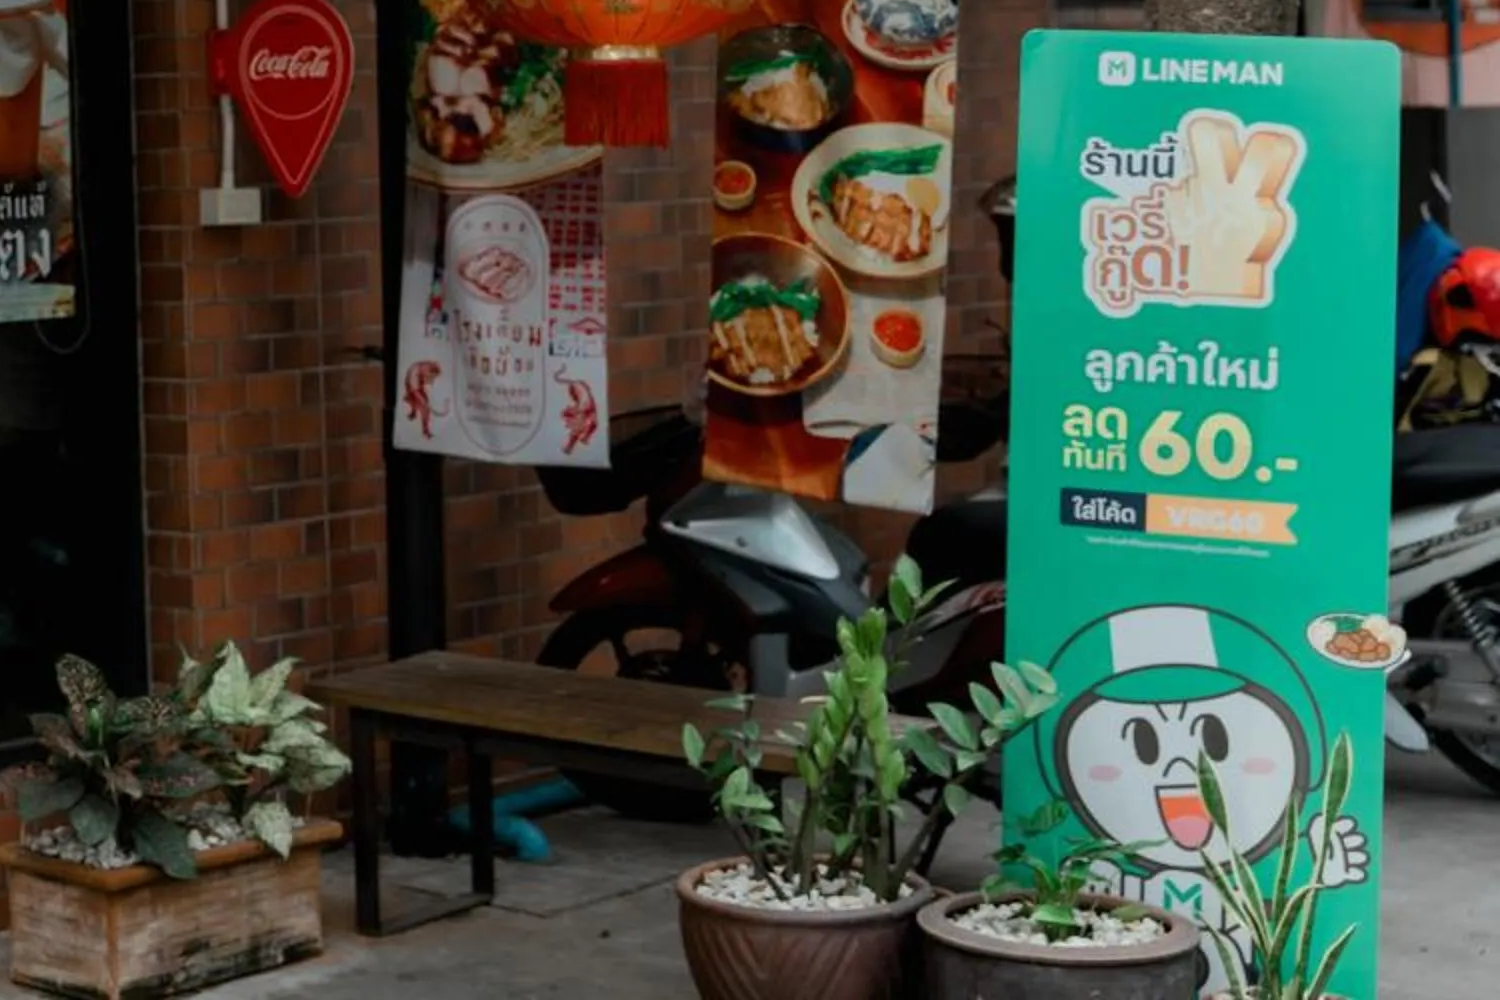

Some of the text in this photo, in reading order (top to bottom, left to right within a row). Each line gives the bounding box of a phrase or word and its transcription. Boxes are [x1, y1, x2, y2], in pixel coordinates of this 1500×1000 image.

[249, 46, 332, 81] Coca-Cola
[1142, 57, 1208, 83] LINE
[1212, 59, 1285, 86] MAN
[1084, 137, 1178, 179] ร้านนี้
[1084, 340, 1279, 392] ลูกค้าใหม่
[1062, 403, 1128, 440] ลด
[1062, 440, 1127, 472] ทันที
[1072, 495, 1136, 525] ใส่โค้ด
